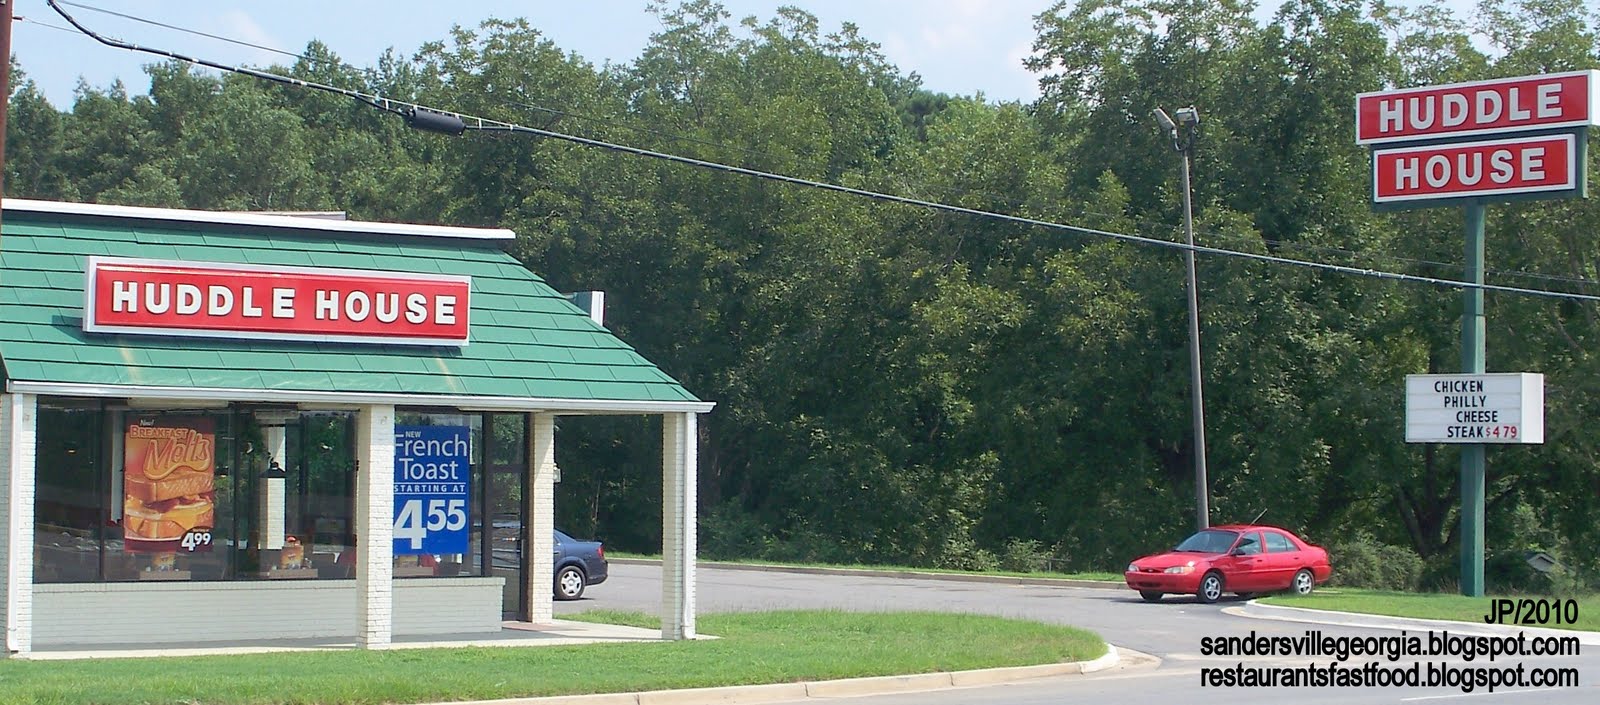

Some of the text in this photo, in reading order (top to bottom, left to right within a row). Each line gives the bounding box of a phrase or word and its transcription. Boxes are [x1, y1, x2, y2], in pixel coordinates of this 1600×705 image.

[1379, 83, 1563, 133] HUDDLE
[1395, 147, 1545, 190] HOUSE
[112, 280, 457, 325] HUDDLE HOUSE
[1434, 380, 1484, 393] CHICKEN
[1444, 395, 1487, 408] PHILLY
[1456, 410, 1498, 423] CHEESE
[130, 425, 189, 438] BREAKFAST
[1447, 425, 1484, 438] STEAK
[143, 429, 210, 472] Melts
[394, 433, 468, 457] French
[398, 457, 459, 480] Toast
[394, 484, 466, 493] STARTING AT
